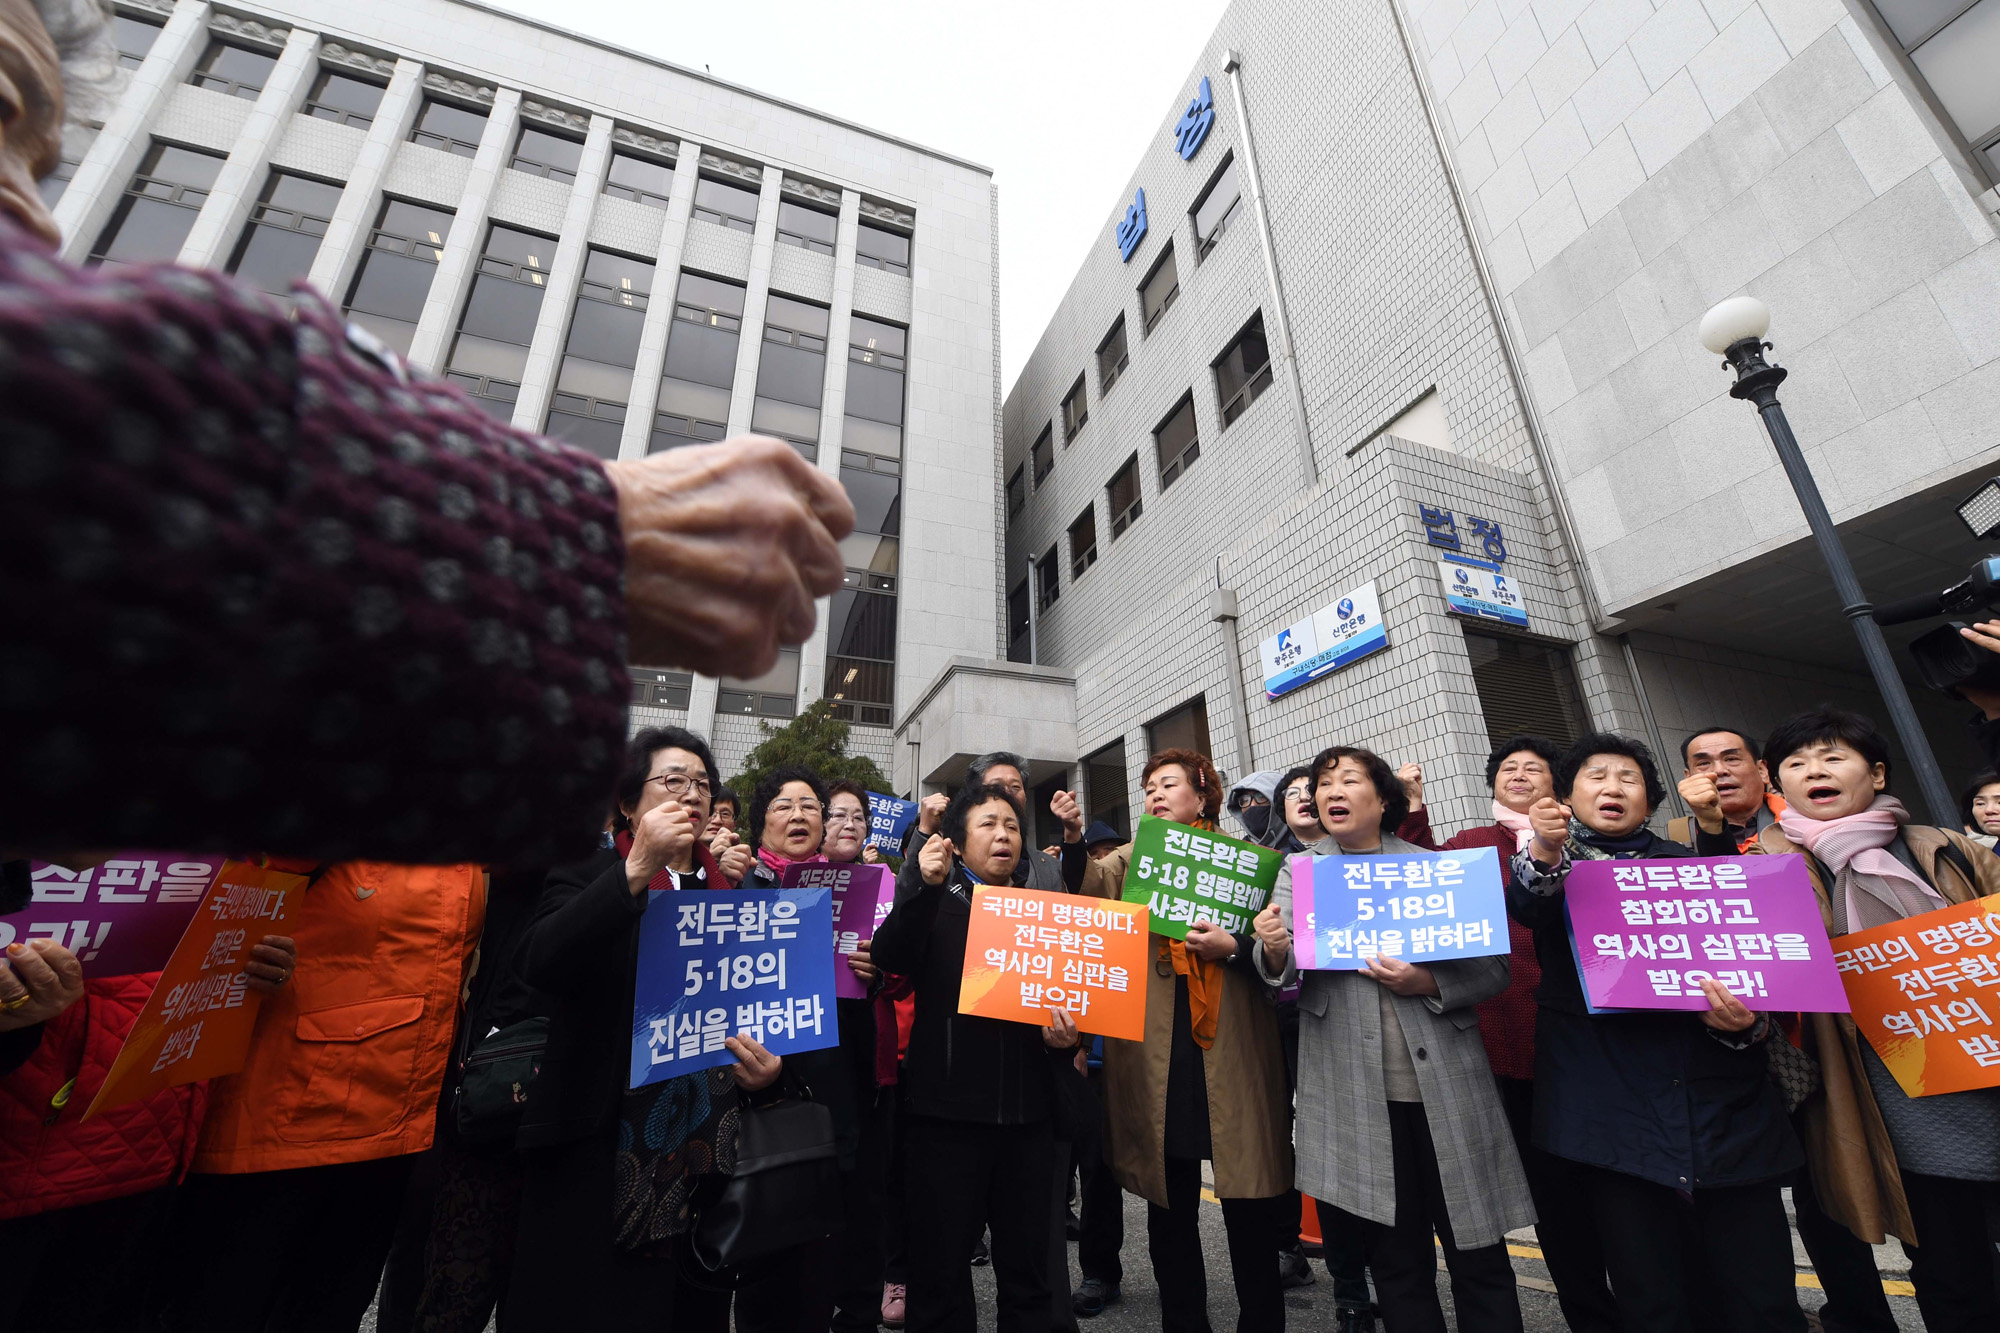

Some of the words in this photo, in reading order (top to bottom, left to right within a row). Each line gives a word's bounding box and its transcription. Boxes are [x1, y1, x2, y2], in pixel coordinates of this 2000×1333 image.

[1116, 75, 1215, 264] 법정
[1418, 503, 1507, 562] 법정
[1452, 583, 1480, 596] 신한은행
[1332, 613, 1366, 638] 신한은행
[1274, 644, 1302, 666] 광주은행
[868, 796, 904, 818] 두환은
[1163, 828, 1260, 878] 전두환은
[31, 860, 212, 903] 심판을
[1137, 856, 1190, 890] 5·18
[1194, 870, 1268, 913] 영령앞에
[1343, 858, 1465, 890] 전두환은
[1612, 863, 1748, 892] 전두환은
[676, 900, 801, 947] 전두환은
[982, 895, 1044, 921] 국민의
[1051, 901, 1138, 935] 명령이다.
[1356, 891, 1456, 920] 5·18의
[1620, 898, 1760, 926] 참회하고
[1014, 924, 1105, 958] 전두환은
[1327, 929, 1405, 960] 진실을
[1410, 919, 1494, 954] 밝혀라
[1592, 933, 1693, 961] 역사의
[1700, 933, 1812, 961] 심판을
[1833, 935, 1920, 976] 국민의
[684, 948, 787, 996] 5·18의
[984, 948, 1053, 979] 역사의
[1062, 963, 1129, 992] 심판을
[1647, 969, 1769, 998] 받으라!
[1891, 952, 2000, 1001] 전두환
[1019, 982, 1091, 1017] 받으라
[1882, 997, 1994, 1039] 역사의
[648, 1007, 730, 1065] 진실을
[736, 994, 825, 1044] 밝혀라
